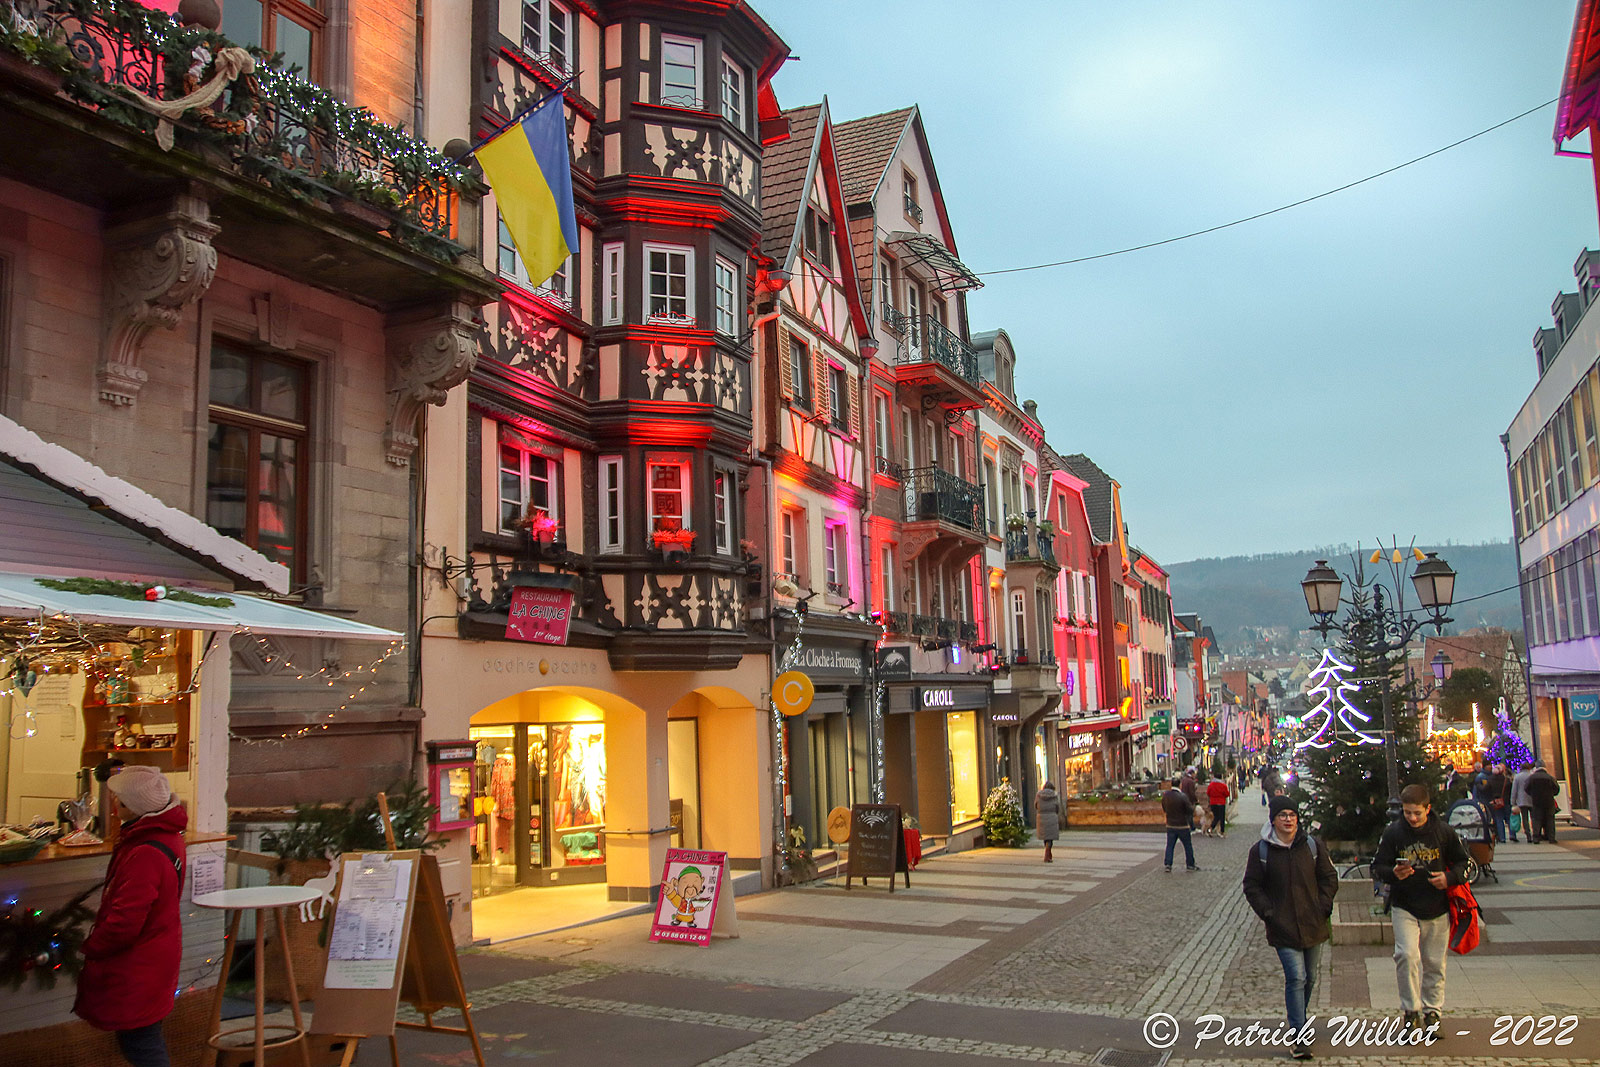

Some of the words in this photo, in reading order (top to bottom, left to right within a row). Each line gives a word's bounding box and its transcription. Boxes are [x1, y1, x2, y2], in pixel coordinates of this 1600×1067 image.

[521, 592, 562, 603] RESTAURANT
[512, 602, 527, 618] LA
[529, 605, 566, 622] CHINE
[806, 648, 830, 668] Cloche
[830, 651, 835, 668] à
[835, 652, 861, 675] Fromage
[783, 681, 803, 706] C
[923, 689, 954, 707] CAROLL
[1573, 701, 1595, 711] Krys
[668, 851, 680, 860] LA
[681, 853, 709, 862] CHINE
